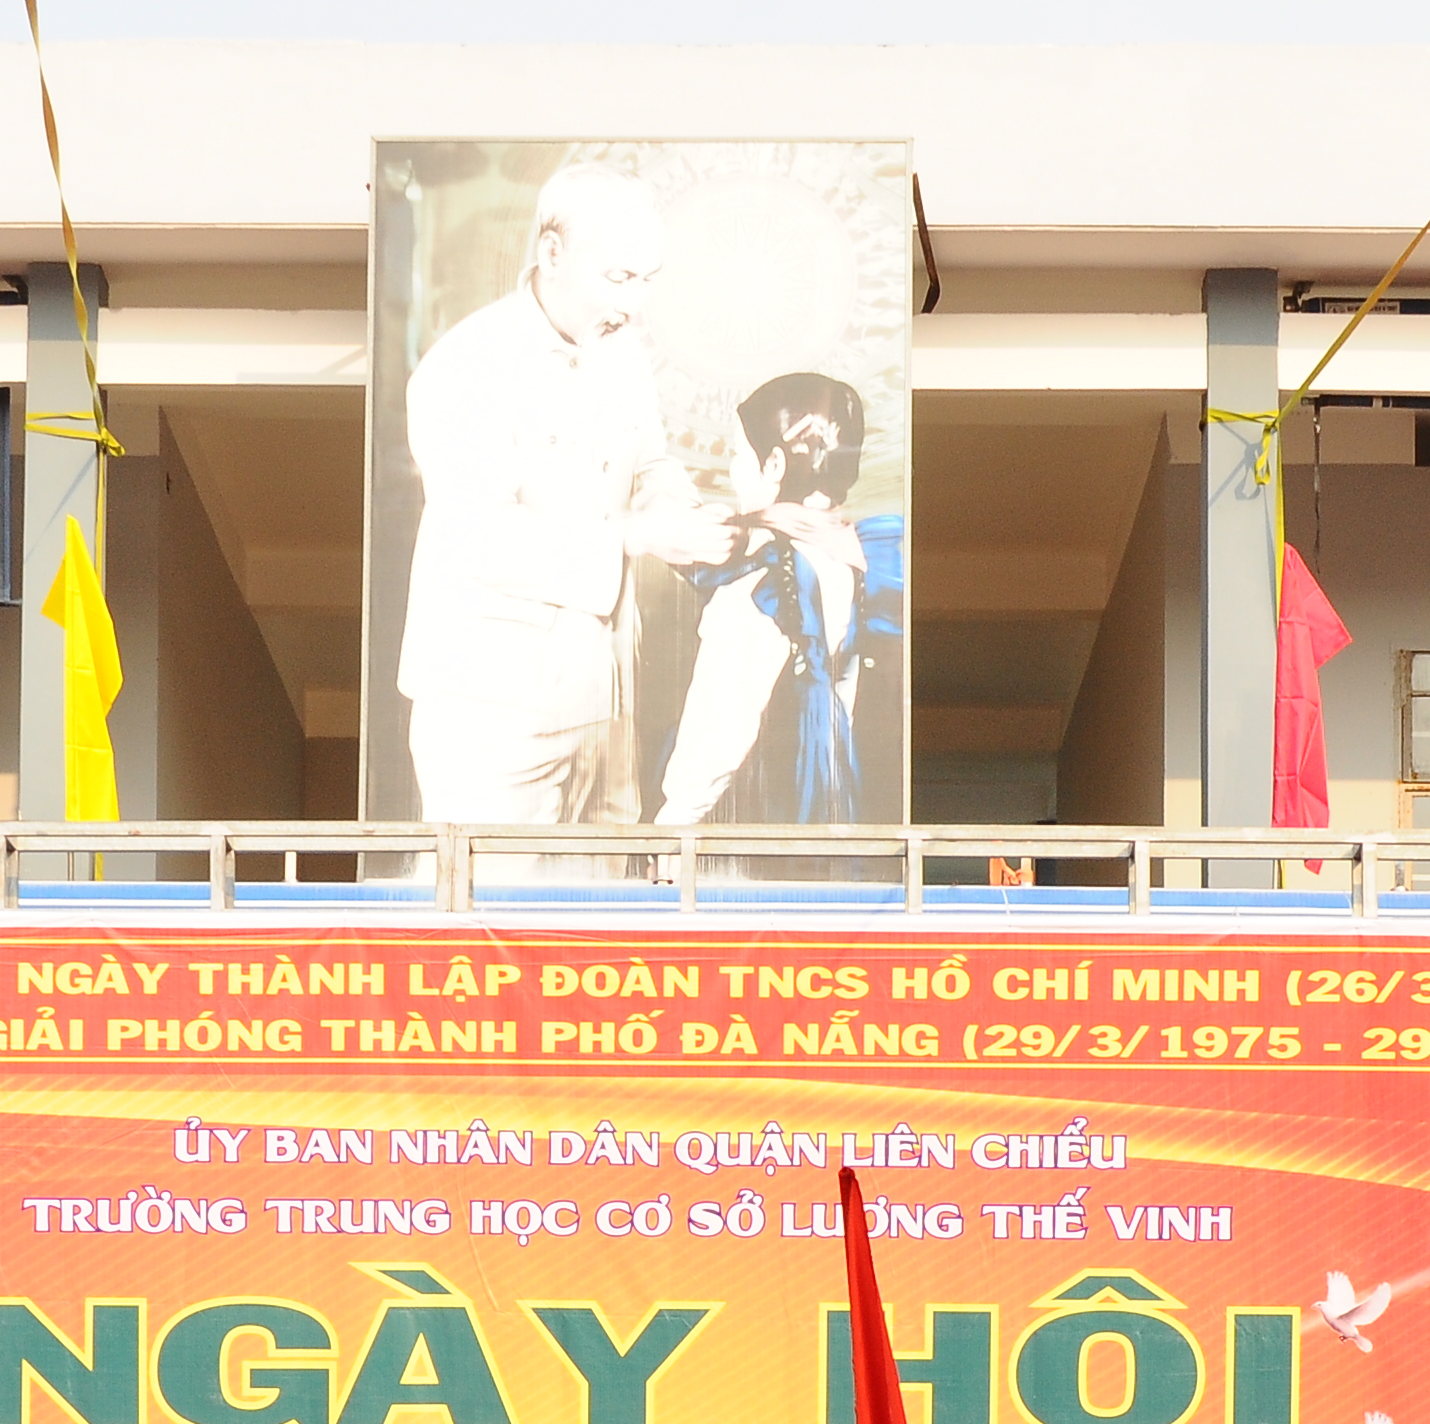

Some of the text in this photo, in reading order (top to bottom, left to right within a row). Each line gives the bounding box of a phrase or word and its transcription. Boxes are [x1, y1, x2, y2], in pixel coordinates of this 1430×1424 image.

[16, 952, 171, 996] NGÀY
[186, 953, 386, 997] THÀNH
[407, 953, 523, 1004] LẬP
[538, 955, 701, 999] ĐOÀN
[717, 964, 871, 1001] TNCS
[890, 952, 972, 1002] HỒ
[991, 959, 1094, 1002] CHÍ
[1111, 967, 1261, 1003] MINH
[105, 1009, 304, 1053] PHÓNG
[319, 1011, 518, 1054] THÀNH
[540, 1008, 666, 1056] PHỐ
[678, 1013, 760, 1056] ĐÀ
[782, 1009, 941, 1058] NẴNG
[961, 1023, 1303, 1062] (29/3/1975
[172, 1116, 1127, 1176] ỦY BAN NHÂN DÂN QUẬN LIÊN CHIỂU
[22, 1185, 247, 1235] TRƯỜNG
[264, 1198, 451, 1236] TRUNG
[470, 1199, 579, 1247] HỌC
[595, 1193, 672, 1237] CƠ
[688, 1188, 766, 1238] SỞ
[981, 1186, 1089, 1240] THẾ
[1105, 1205, 1232, 1242] VINH
